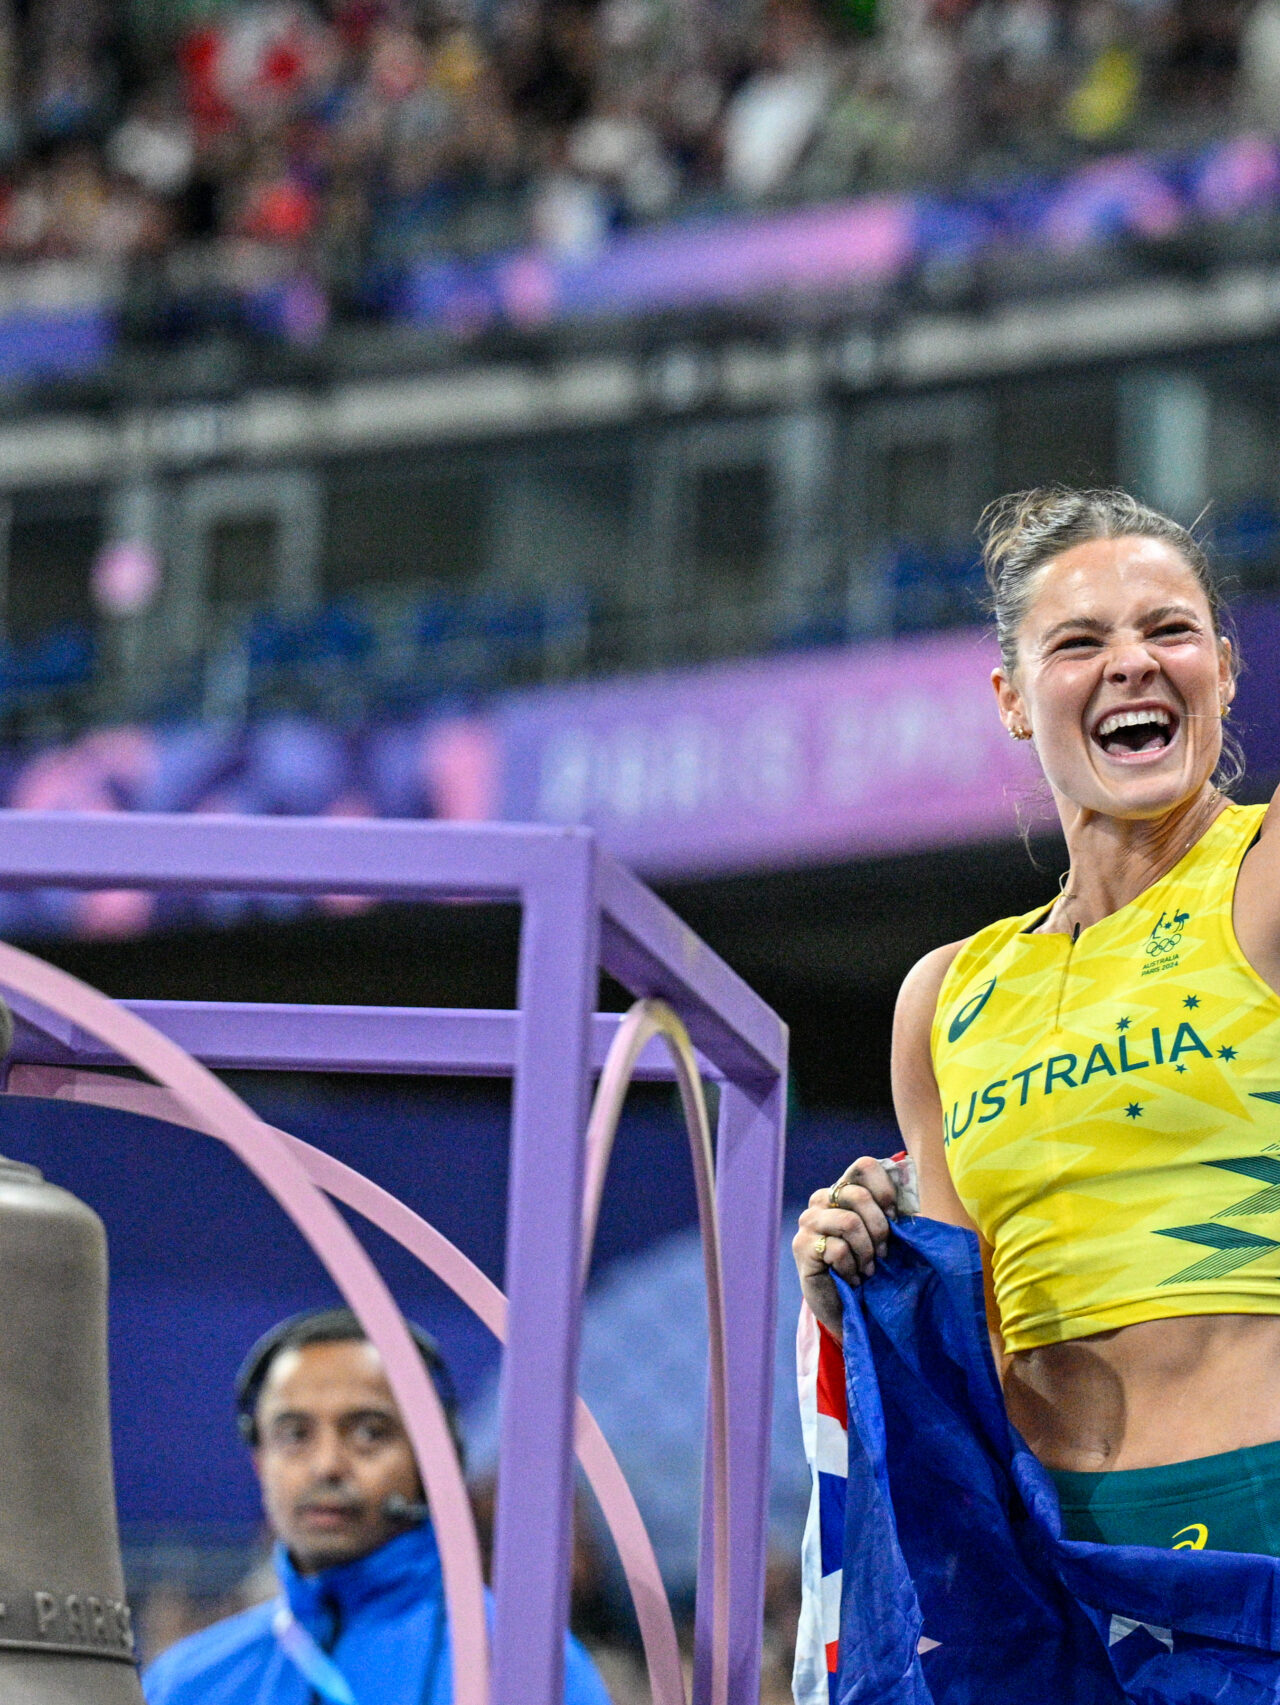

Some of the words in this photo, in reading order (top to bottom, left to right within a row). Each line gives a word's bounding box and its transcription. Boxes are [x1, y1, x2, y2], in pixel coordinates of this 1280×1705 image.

[1141, 967, 1160, 976] PARIS
[1162, 961, 1178, 970] 2024
[1143, 954, 1179, 969] AUSTRALIA
[943, 1022, 1213, 1147] AUSTRALIA
